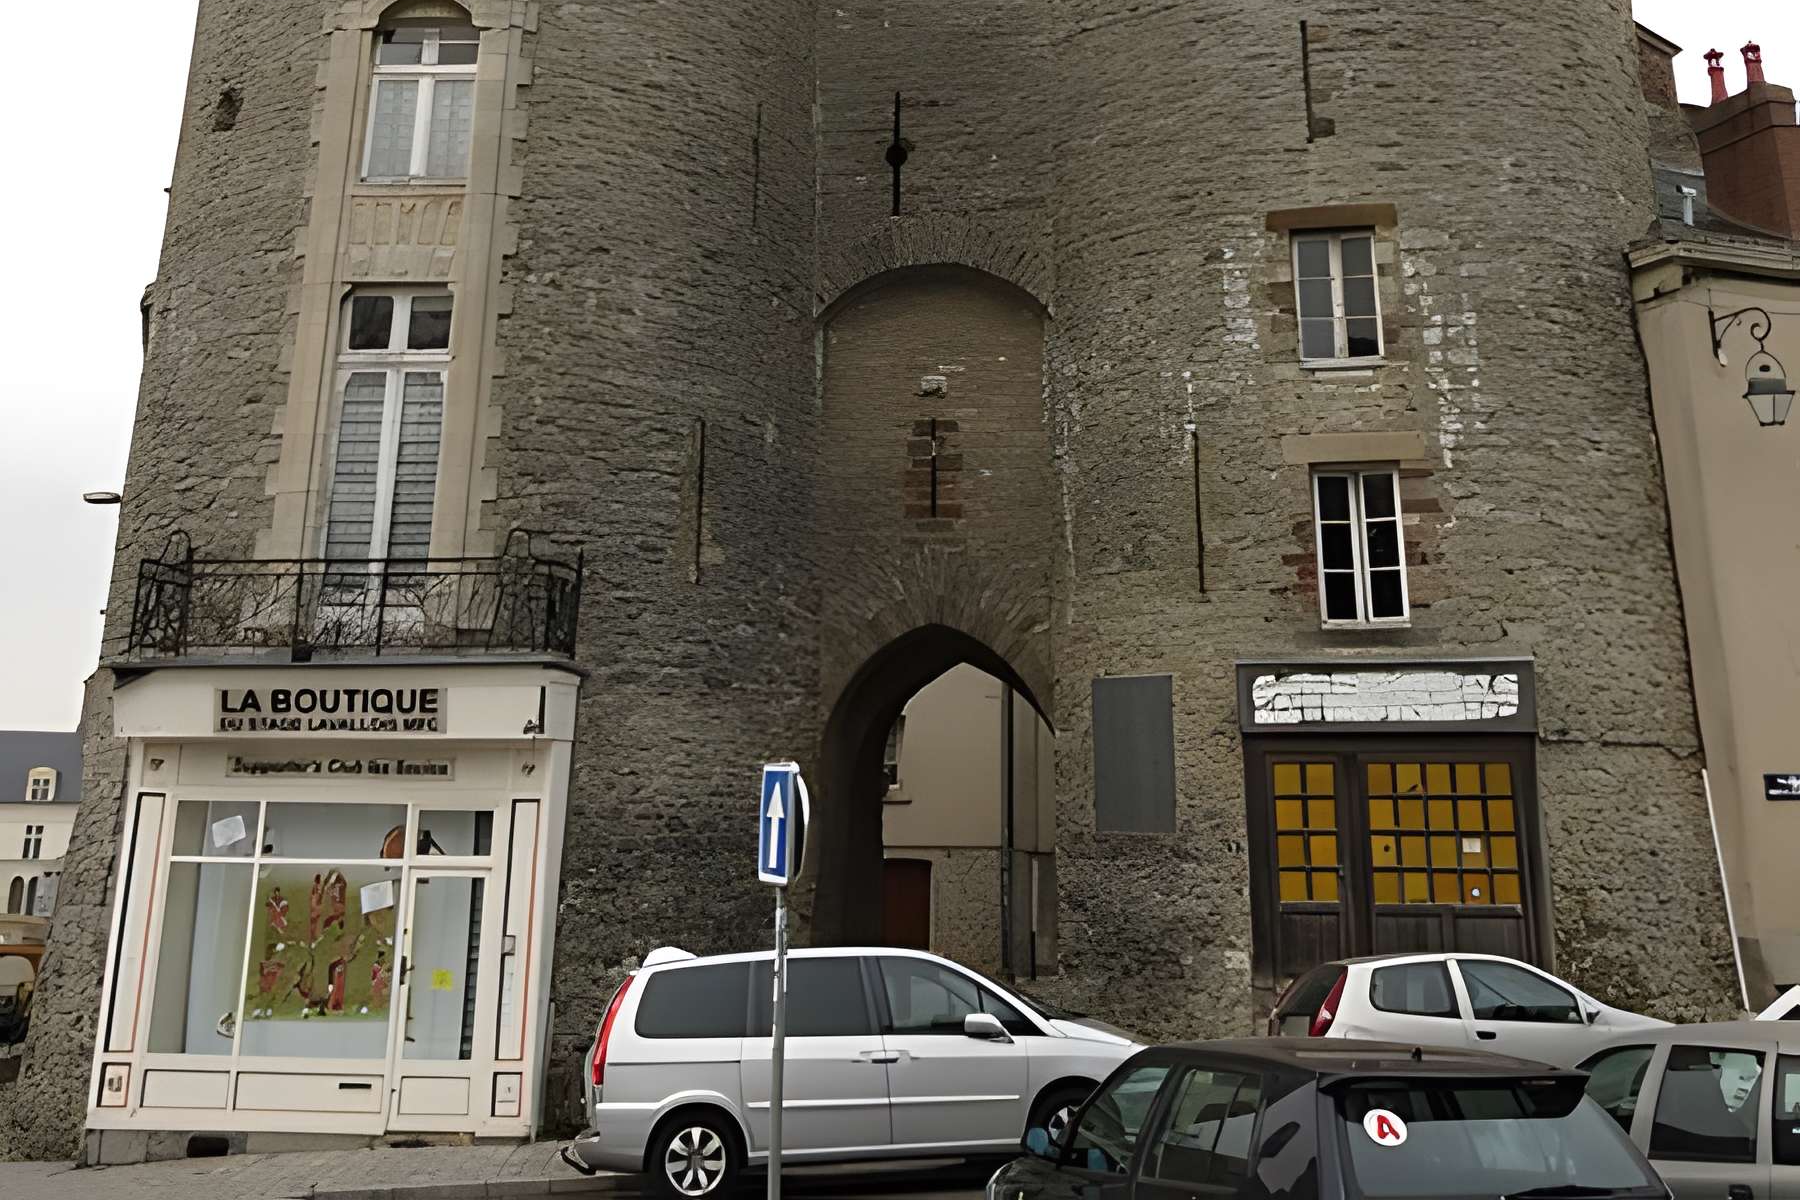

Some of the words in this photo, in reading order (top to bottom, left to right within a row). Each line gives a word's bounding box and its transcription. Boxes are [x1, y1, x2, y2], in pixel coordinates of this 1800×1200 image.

[221, 689, 261, 713] LA
[271, 688, 438, 714] BOUTIQUE
[1377, 1115, 1400, 1140] A
